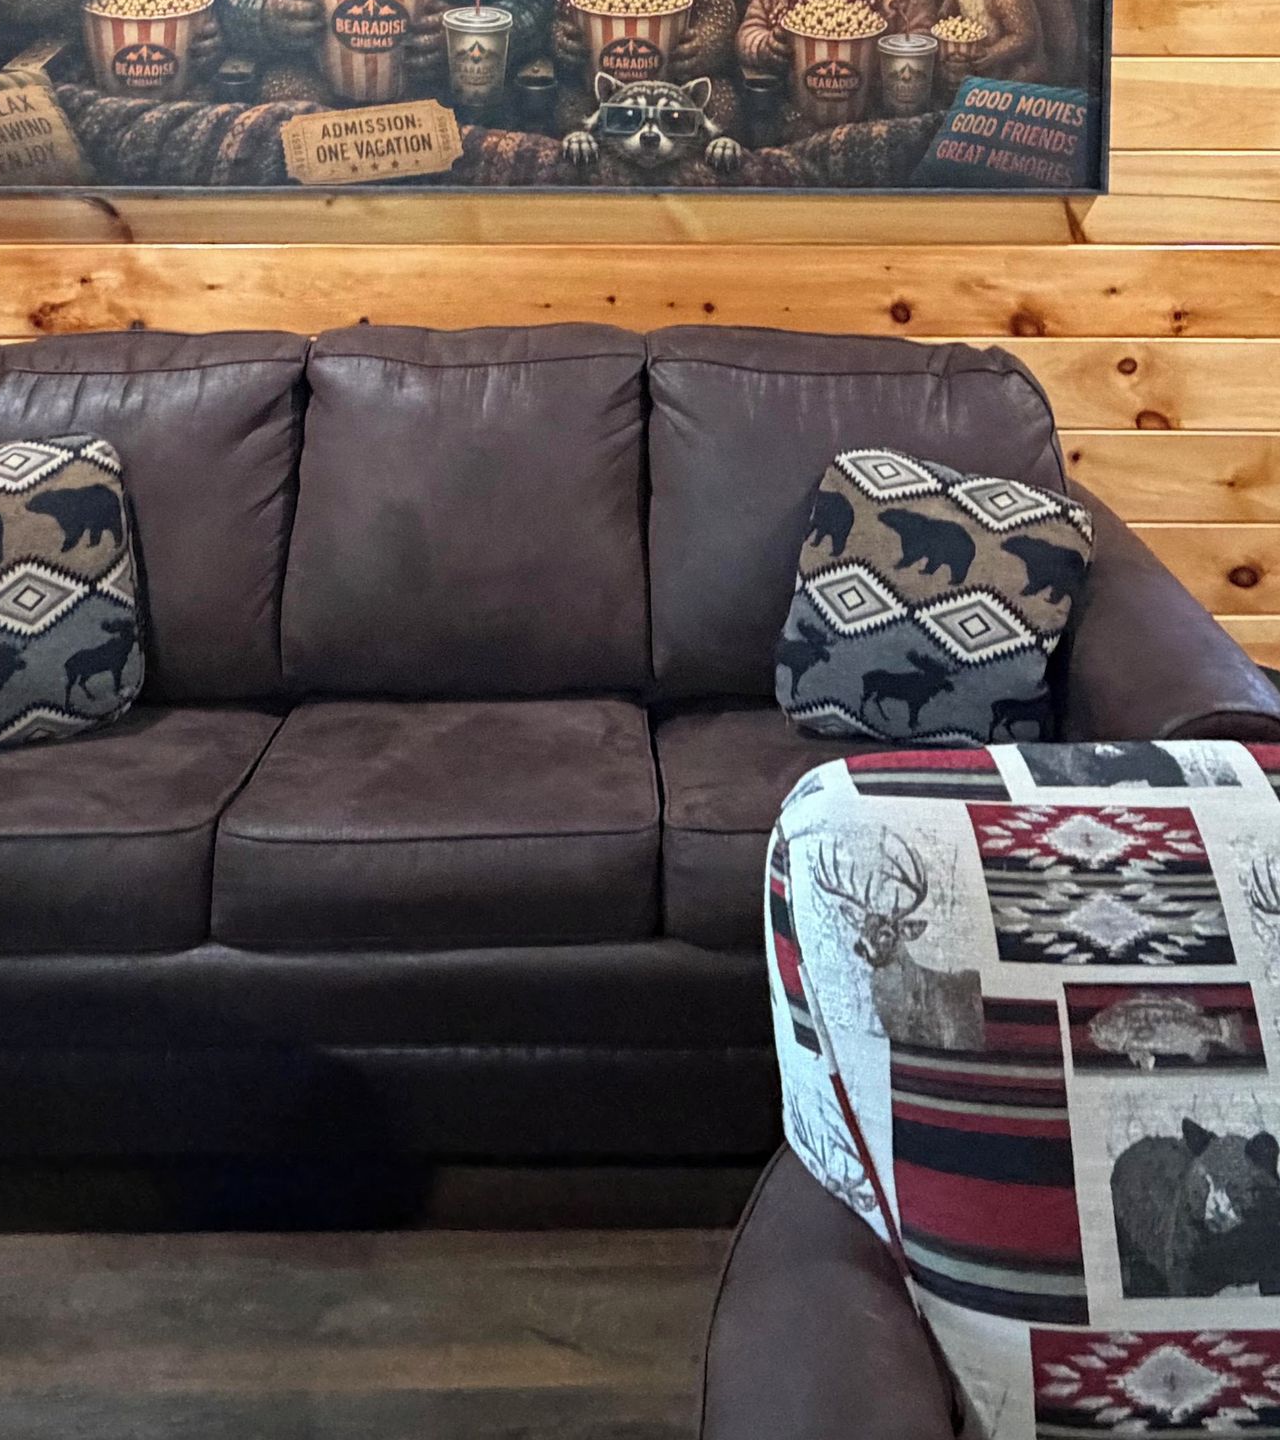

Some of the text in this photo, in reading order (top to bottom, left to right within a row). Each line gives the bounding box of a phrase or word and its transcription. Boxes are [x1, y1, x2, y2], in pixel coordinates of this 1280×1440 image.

[336, 17, 407, 36] BEARADISE
[965, 88, 1088, 128] GOOD MOVIES
[321, 113, 423, 140] ADMISSION:
[951, 113, 1079, 156] GOOD FRIENDS
[316, 142, 351, 164] ONE
[354, 133, 432, 160] VACATION
[935, 140, 1073, 185] GREAT MEMORIES
